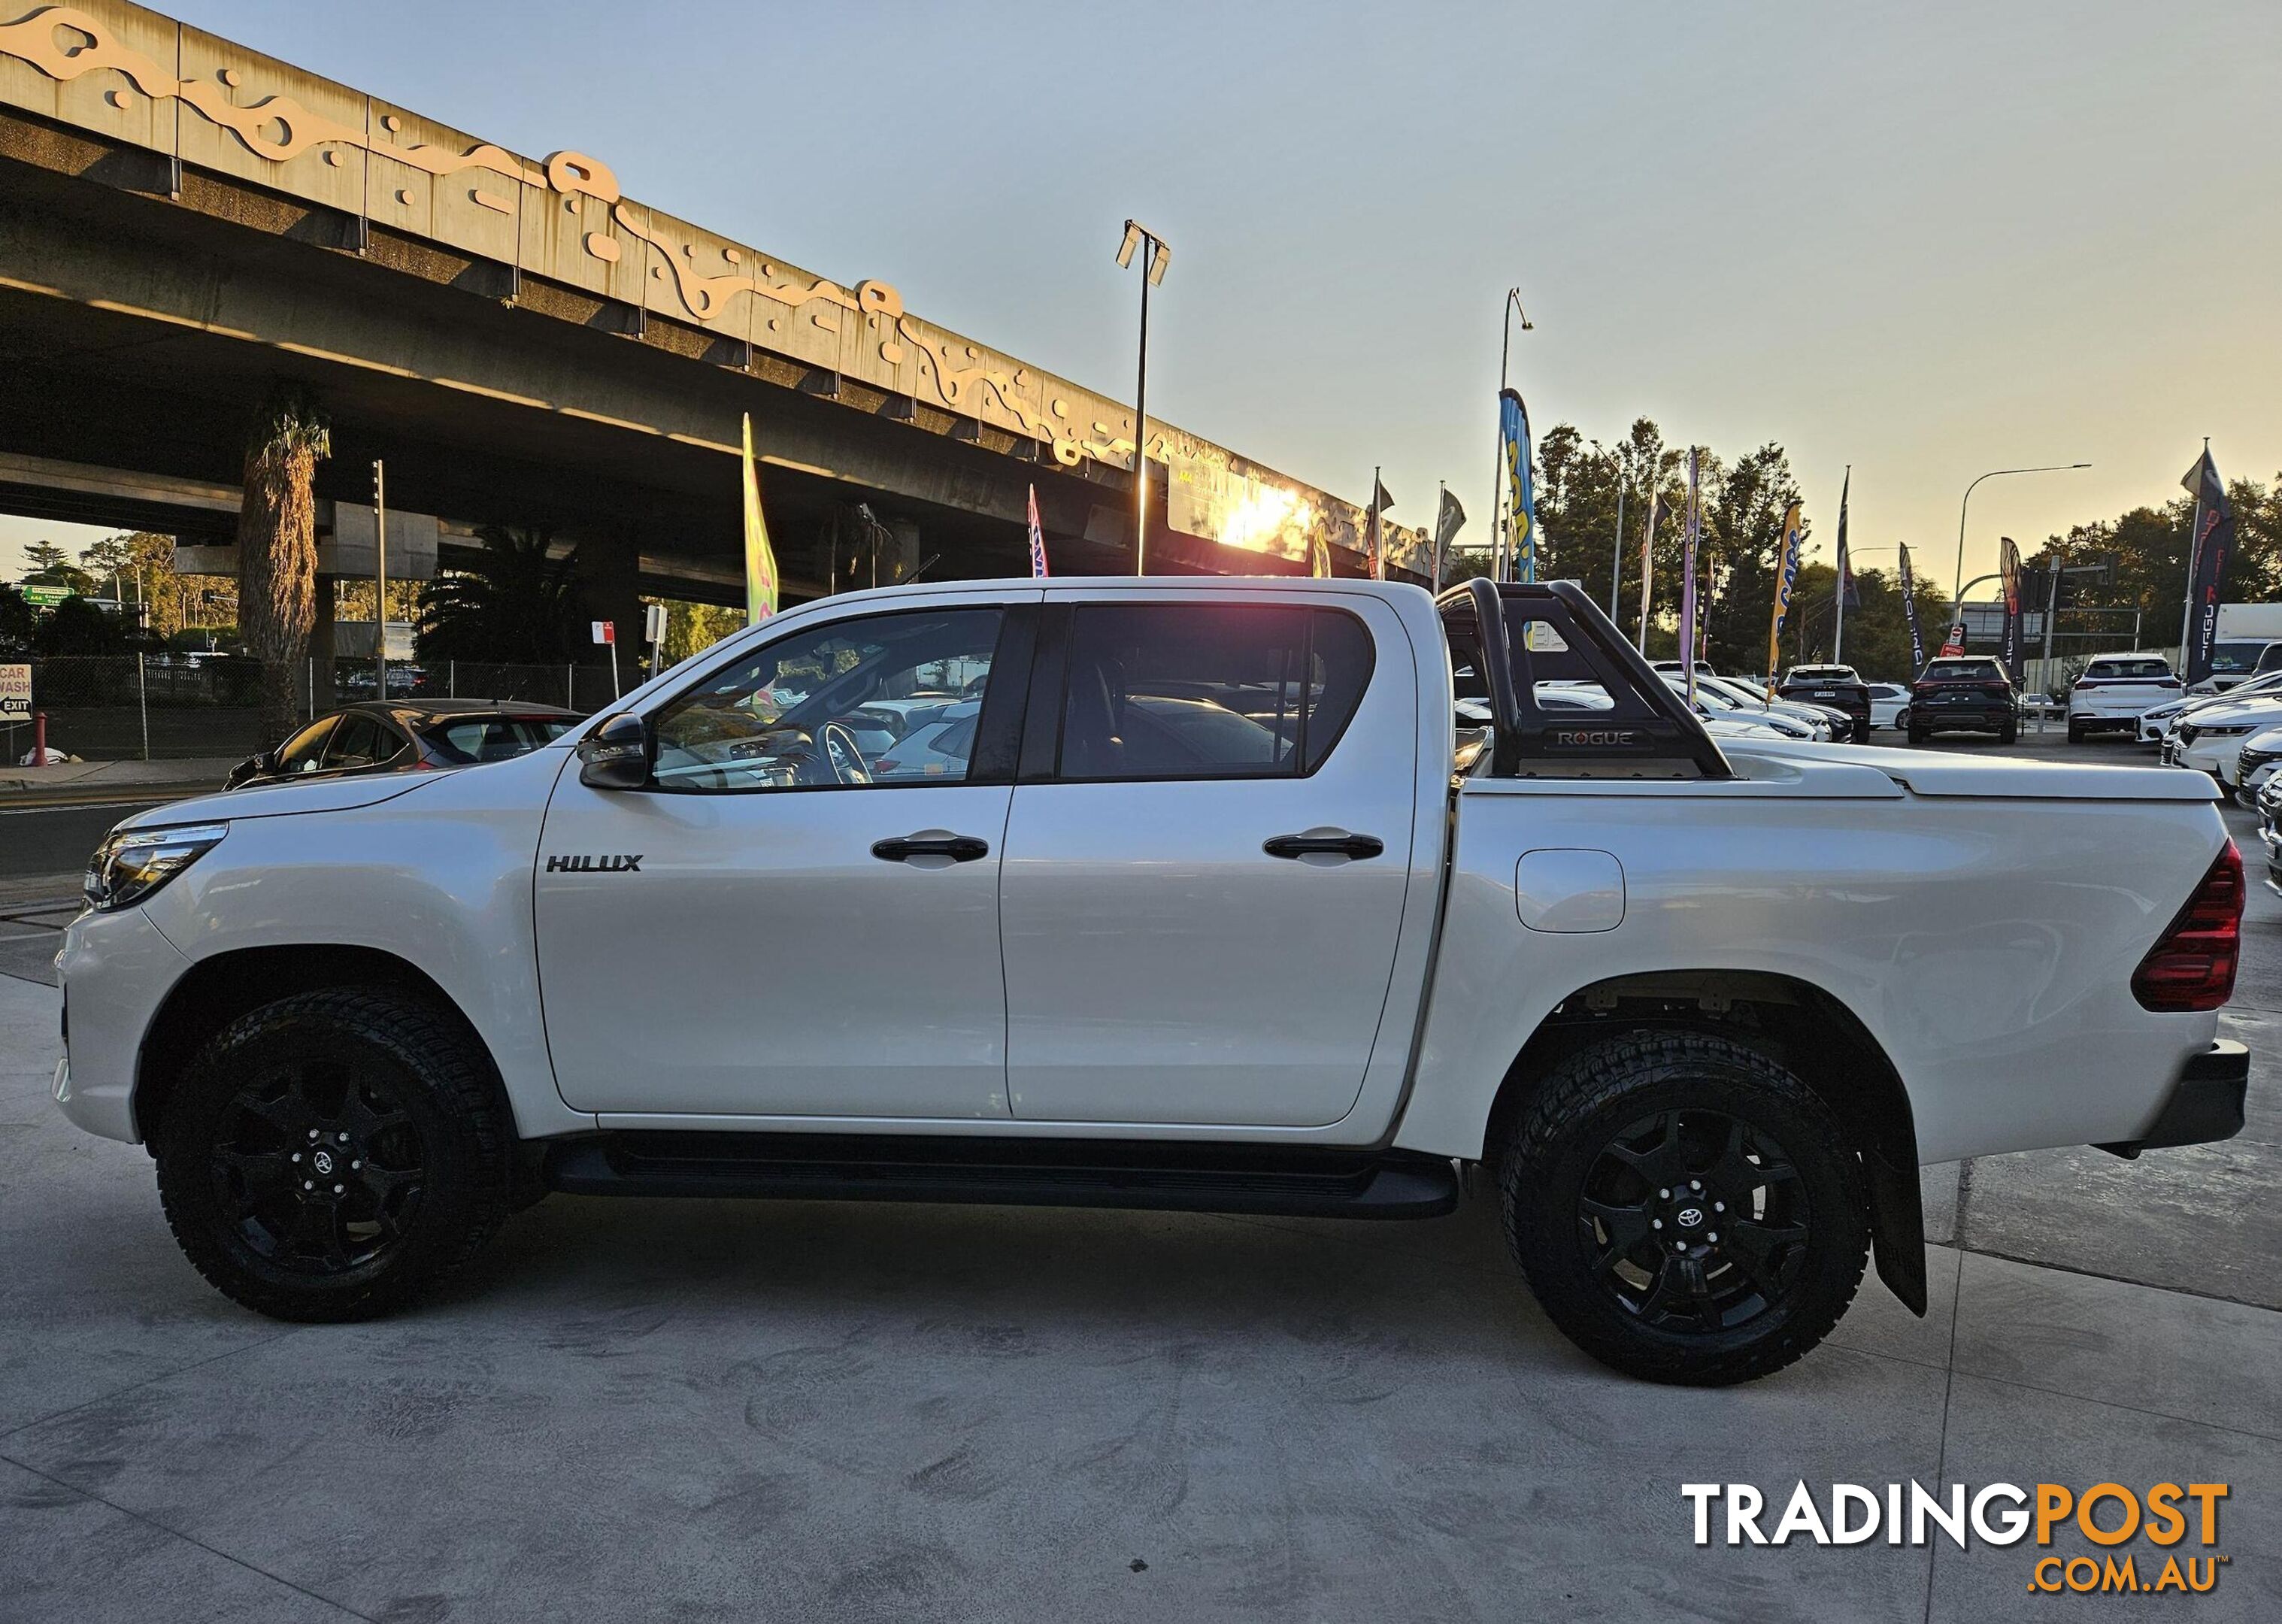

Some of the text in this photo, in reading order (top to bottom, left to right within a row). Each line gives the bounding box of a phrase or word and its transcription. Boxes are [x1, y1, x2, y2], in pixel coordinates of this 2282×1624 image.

[0, 668, 25, 678] CAR
[4, 701, 29, 710] EXIT
[1558, 732, 1635, 745] ROGUE
[546, 855, 644, 872] HILUX
